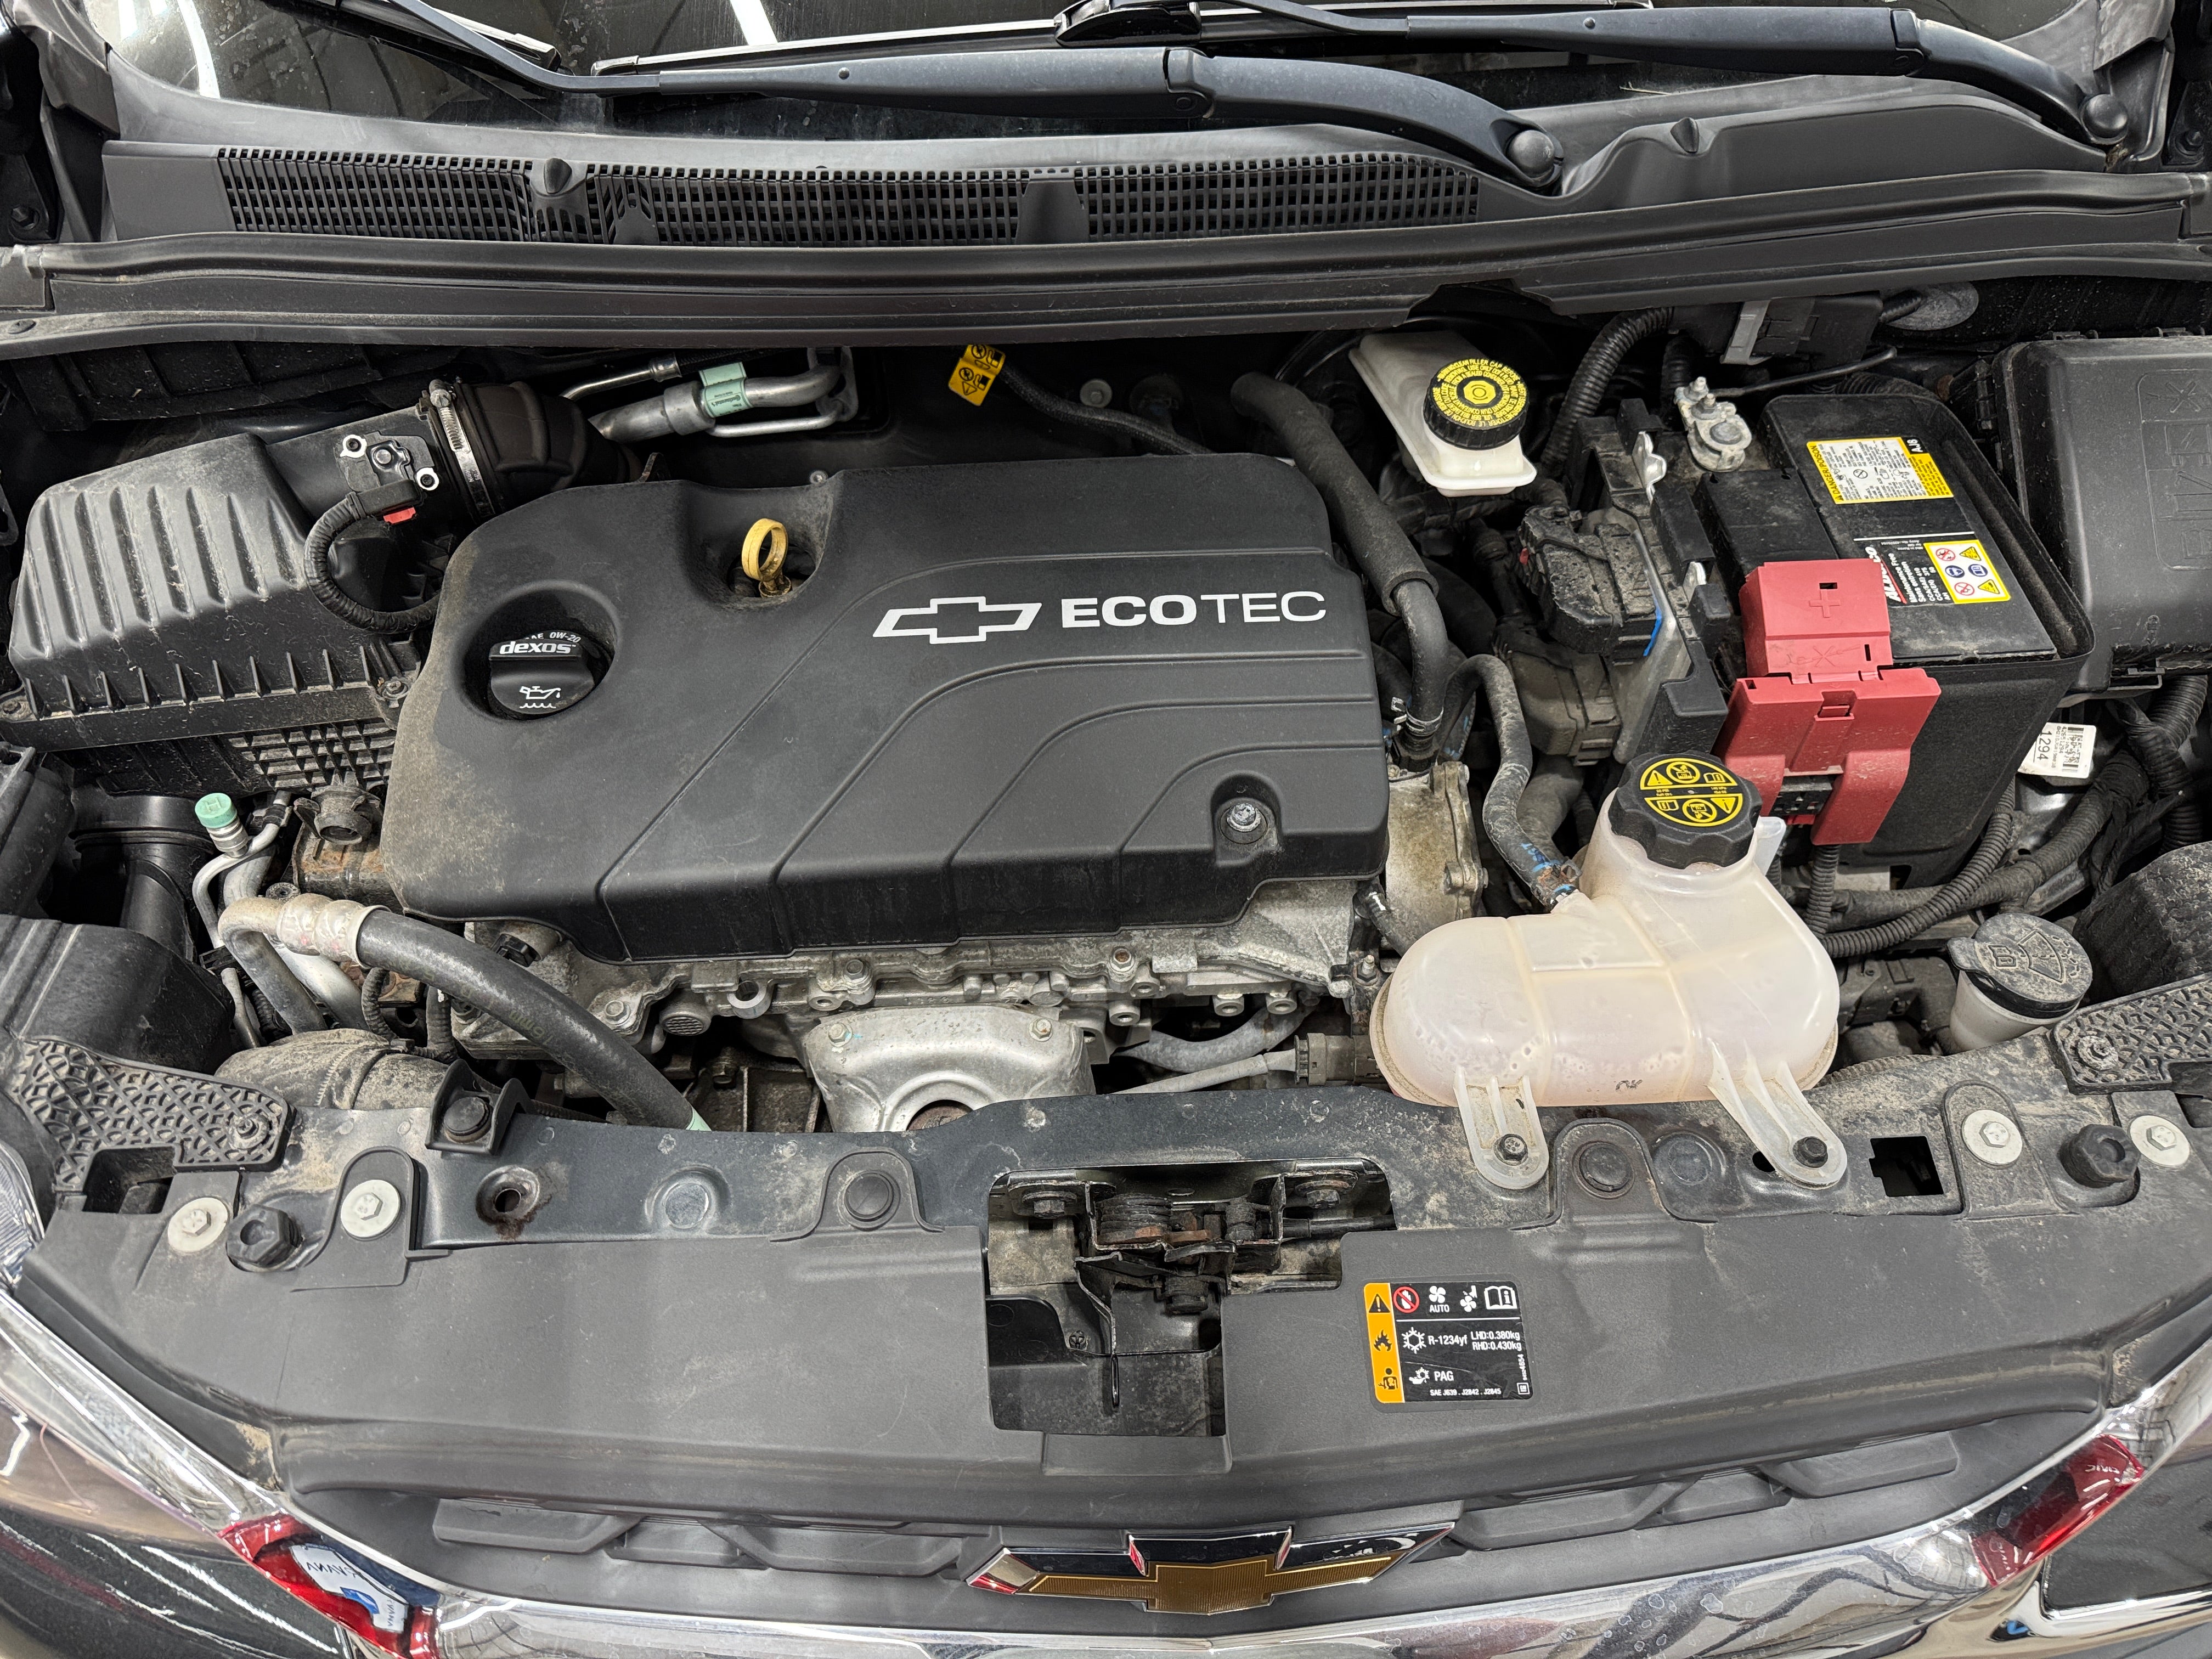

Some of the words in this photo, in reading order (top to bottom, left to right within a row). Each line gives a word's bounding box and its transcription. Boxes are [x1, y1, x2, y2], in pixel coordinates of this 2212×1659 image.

[1489, 360, 1503, 370] CAP
[715, 394, 741, 406] Continental
[1905, 438, 1923, 452] AJ8
[1810, 445, 1838, 494] DANGER/POISON
[1887, 552, 1899, 566] Free
[1893, 566, 1918, 602] Maintenance
[1061, 590, 1327, 628] ECOTEC
[549, 631, 582, 644] 0W-20
[499, 641, 572, 654] dexos
[2036, 731, 2052, 760] 1294
[506, 1008, 555, 1047] 16mm
[1429, 1304, 1450, 1313] AUTO
[1427, 1334, 1468, 1346] R-1234yf
[1470, 1331, 1521, 1341] LHD:0.380kg
[1472, 1341, 1522, 1352] RHD:0.430kg
[1434, 1370, 1454, 1382] PAG
